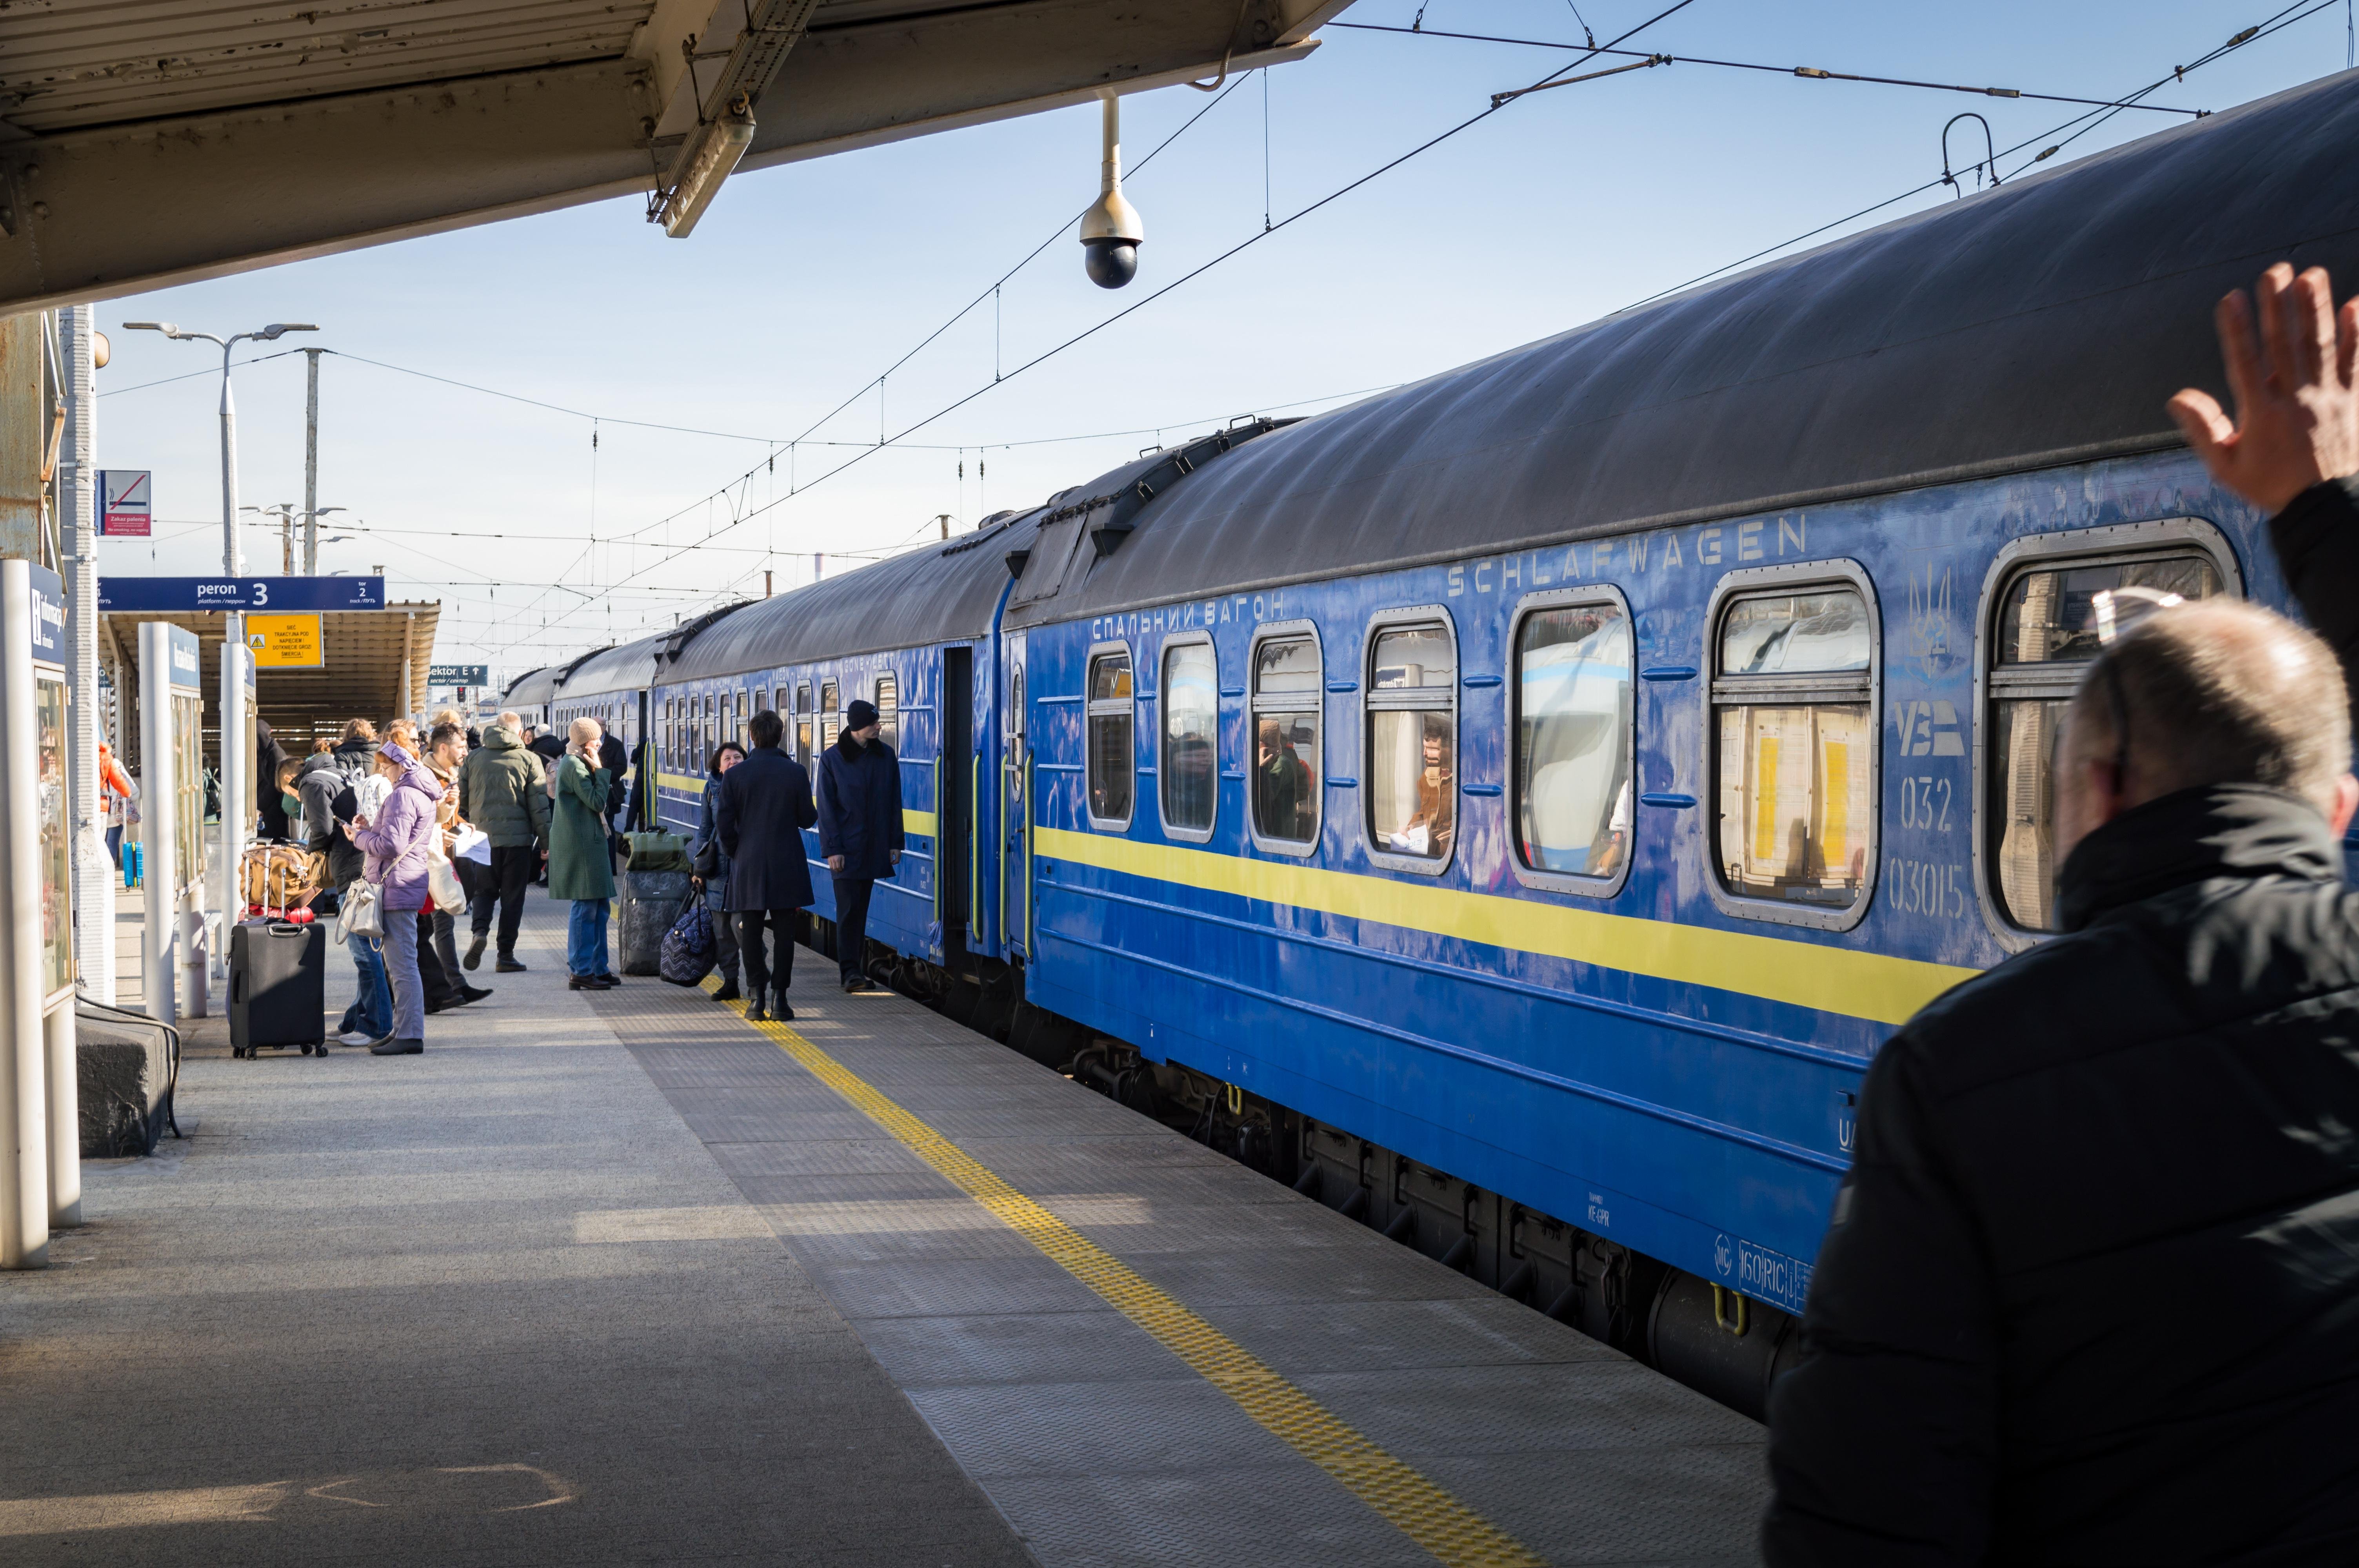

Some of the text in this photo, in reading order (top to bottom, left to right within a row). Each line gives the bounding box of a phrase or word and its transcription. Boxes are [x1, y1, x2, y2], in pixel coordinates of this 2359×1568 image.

[1448, 514, 1805, 597] SCHLAFWAGEN
[198, 583, 268, 605] peron 3
[359, 588, 366, 597] 2
[1093, 592, 1283, 639] СПАЛЬНИЙ ВАГОН
[462, 666, 468, 675] E
[1901, 777, 1951, 831] 032
[1889, 857, 1963, 919] 03015
[1764, 1257, 1784, 1294] RIC
